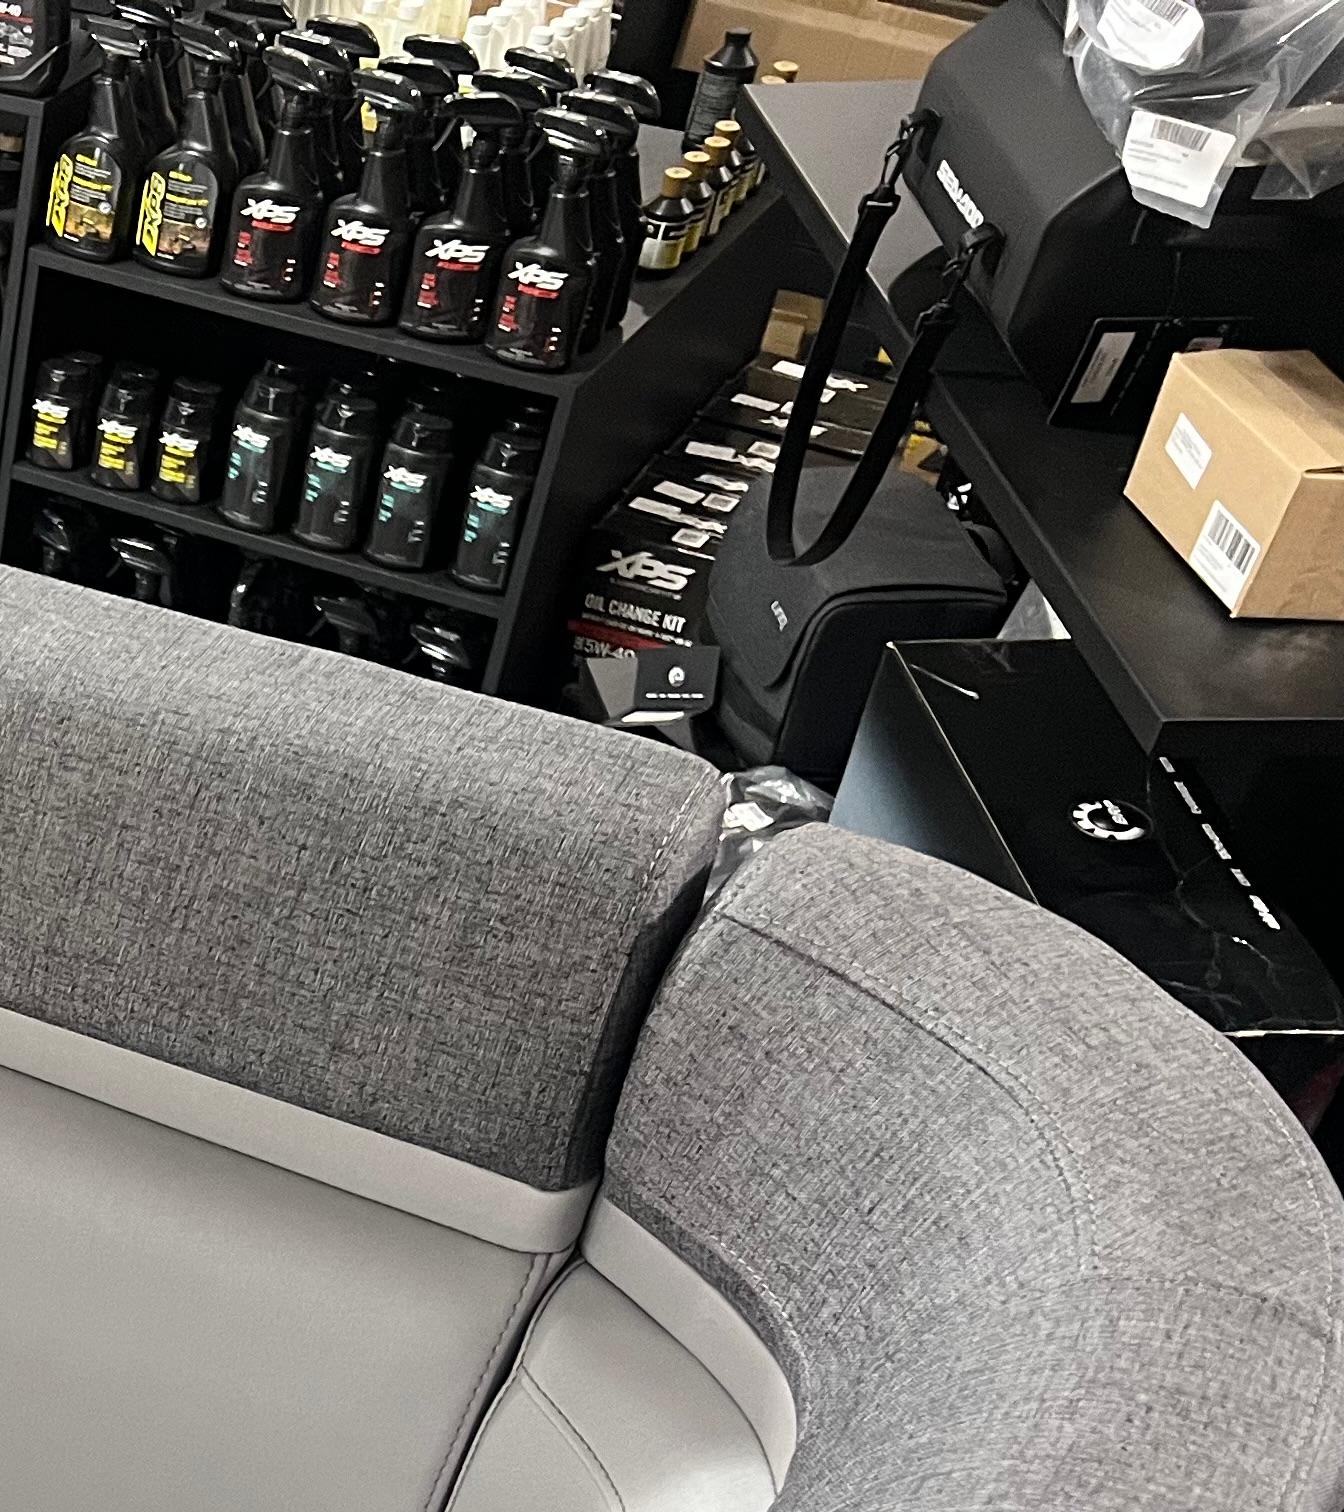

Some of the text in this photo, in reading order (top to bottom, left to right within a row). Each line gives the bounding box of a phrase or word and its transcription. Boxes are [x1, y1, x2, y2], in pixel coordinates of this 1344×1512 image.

[240, 198, 301, 224] XPS
[331, 219, 391, 247] XPS
[425, 239, 491, 263] XPS
[507, 261, 570, 291] XPS
[595, 549, 696, 591] XPS
[608, 599, 662, 628] CHANGE
[662, 611, 687, 633] KIT
